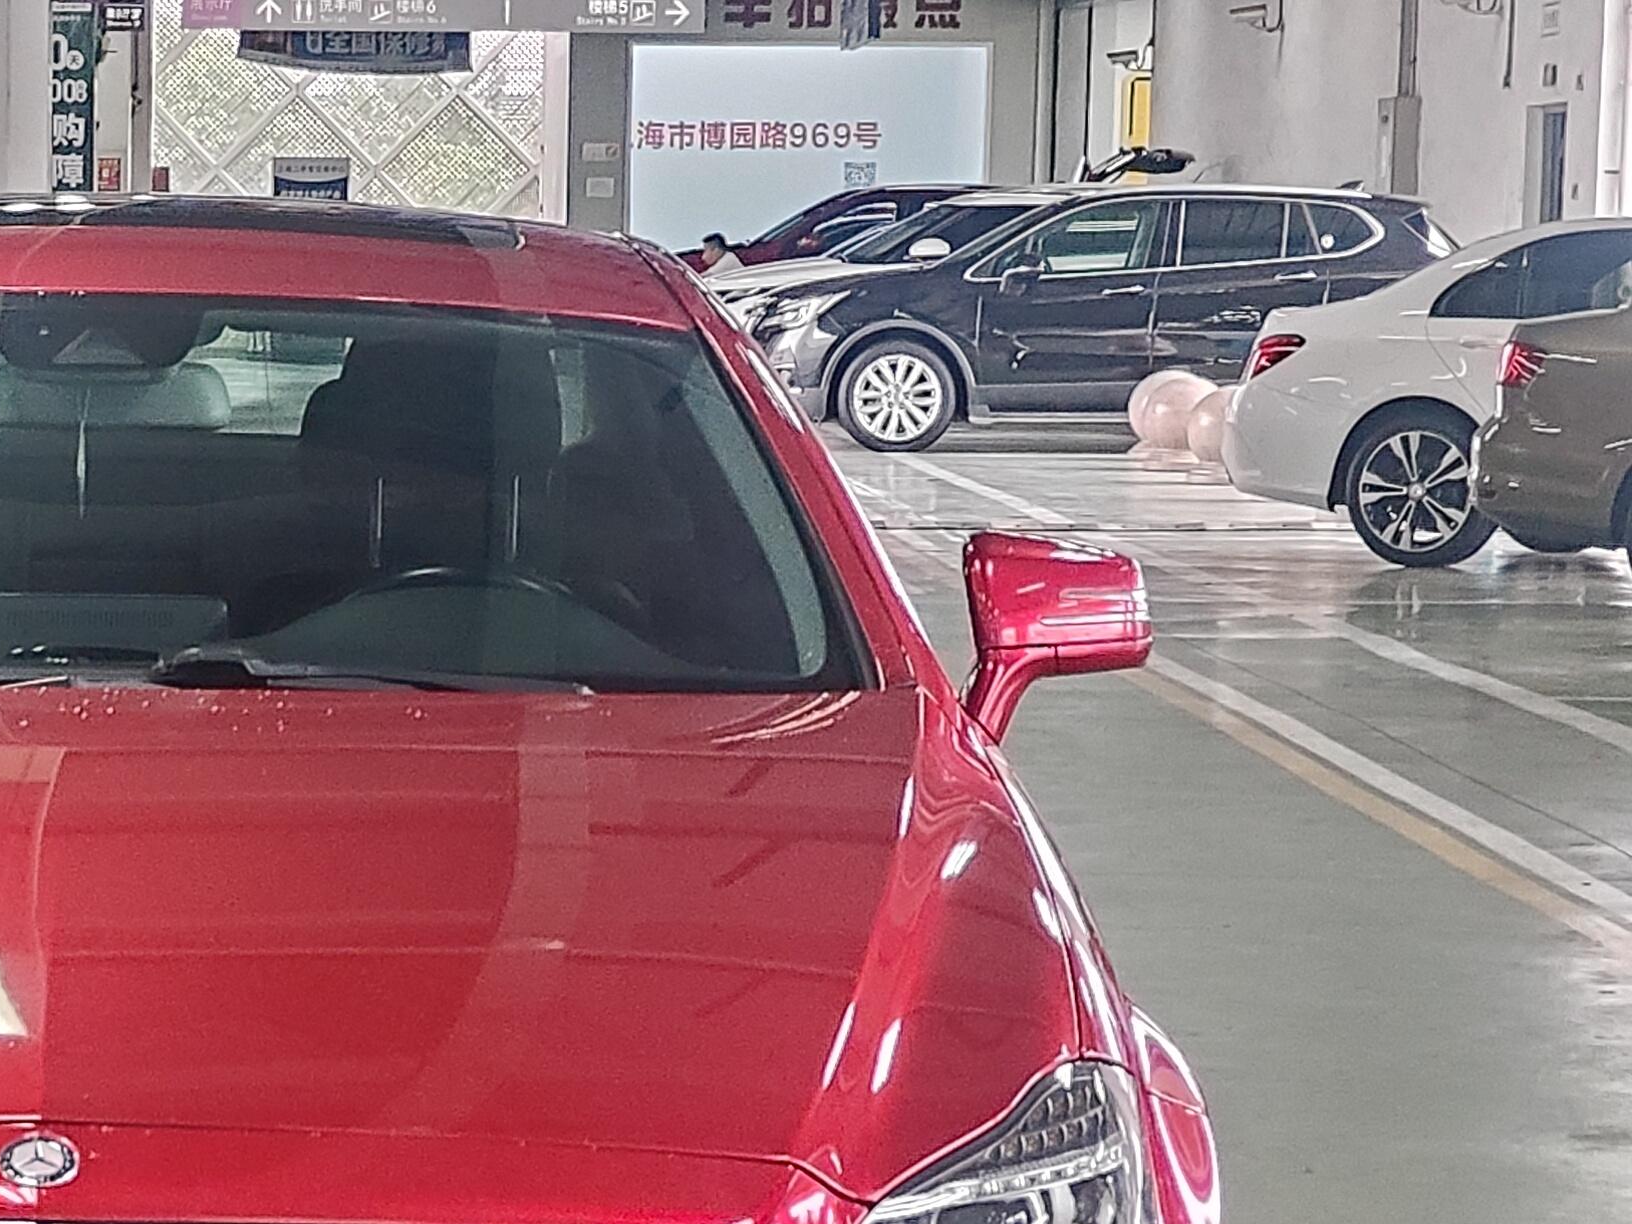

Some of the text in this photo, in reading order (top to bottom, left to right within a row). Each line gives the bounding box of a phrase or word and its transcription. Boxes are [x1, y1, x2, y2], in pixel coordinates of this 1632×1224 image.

[636, 120, 882, 151] 海市博园路969号
